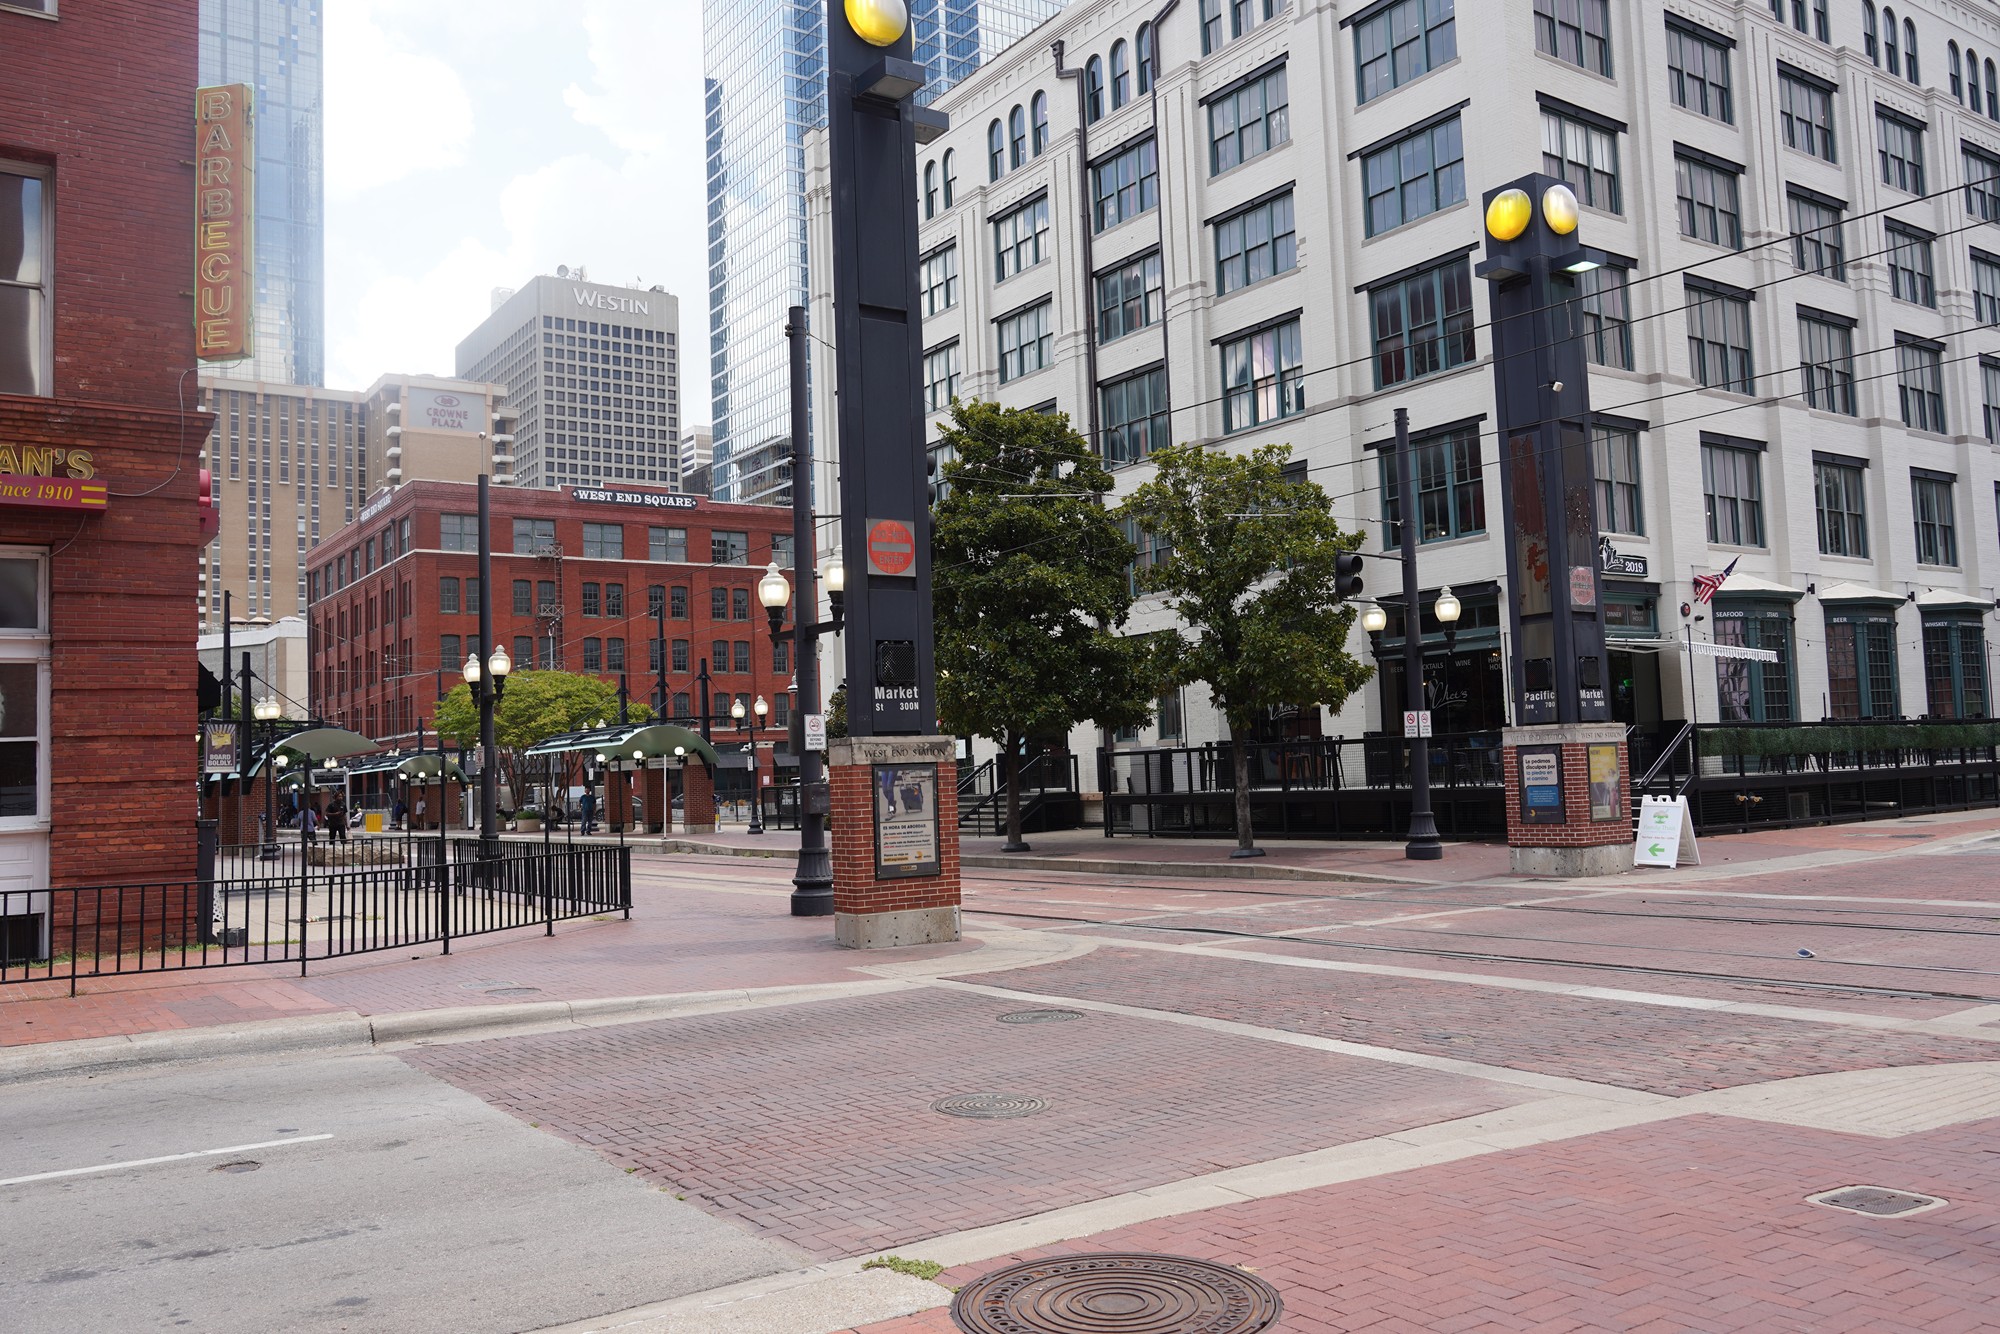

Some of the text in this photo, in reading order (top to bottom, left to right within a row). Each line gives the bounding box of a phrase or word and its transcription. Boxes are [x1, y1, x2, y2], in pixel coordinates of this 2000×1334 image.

[201, 91, 231, 348] BARBECUE
[572, 287, 648, 315] WESTIN
[426, 407, 468, 420] CROWNE
[431, 417, 463, 429] PLAZA
[37, 484, 73, 500] 1910
[577, 489, 692, 507] WEST END SQUARE
[879, 555, 904, 565] ENTER
[1625, 561, 1644, 573] 2019
[1422, 662, 1444, 671] CKTAILS
[1455, 659, 1471, 667] WINE
[1489, 663, 1503, 671] HOU
[874, 686, 919, 700] Market
[1524, 690, 1556, 702] Pacific
[1580, 689, 1604, 699] Market
[875, 702, 919, 712] St 300N
[864, 747, 946, 758] WEST END STATION
